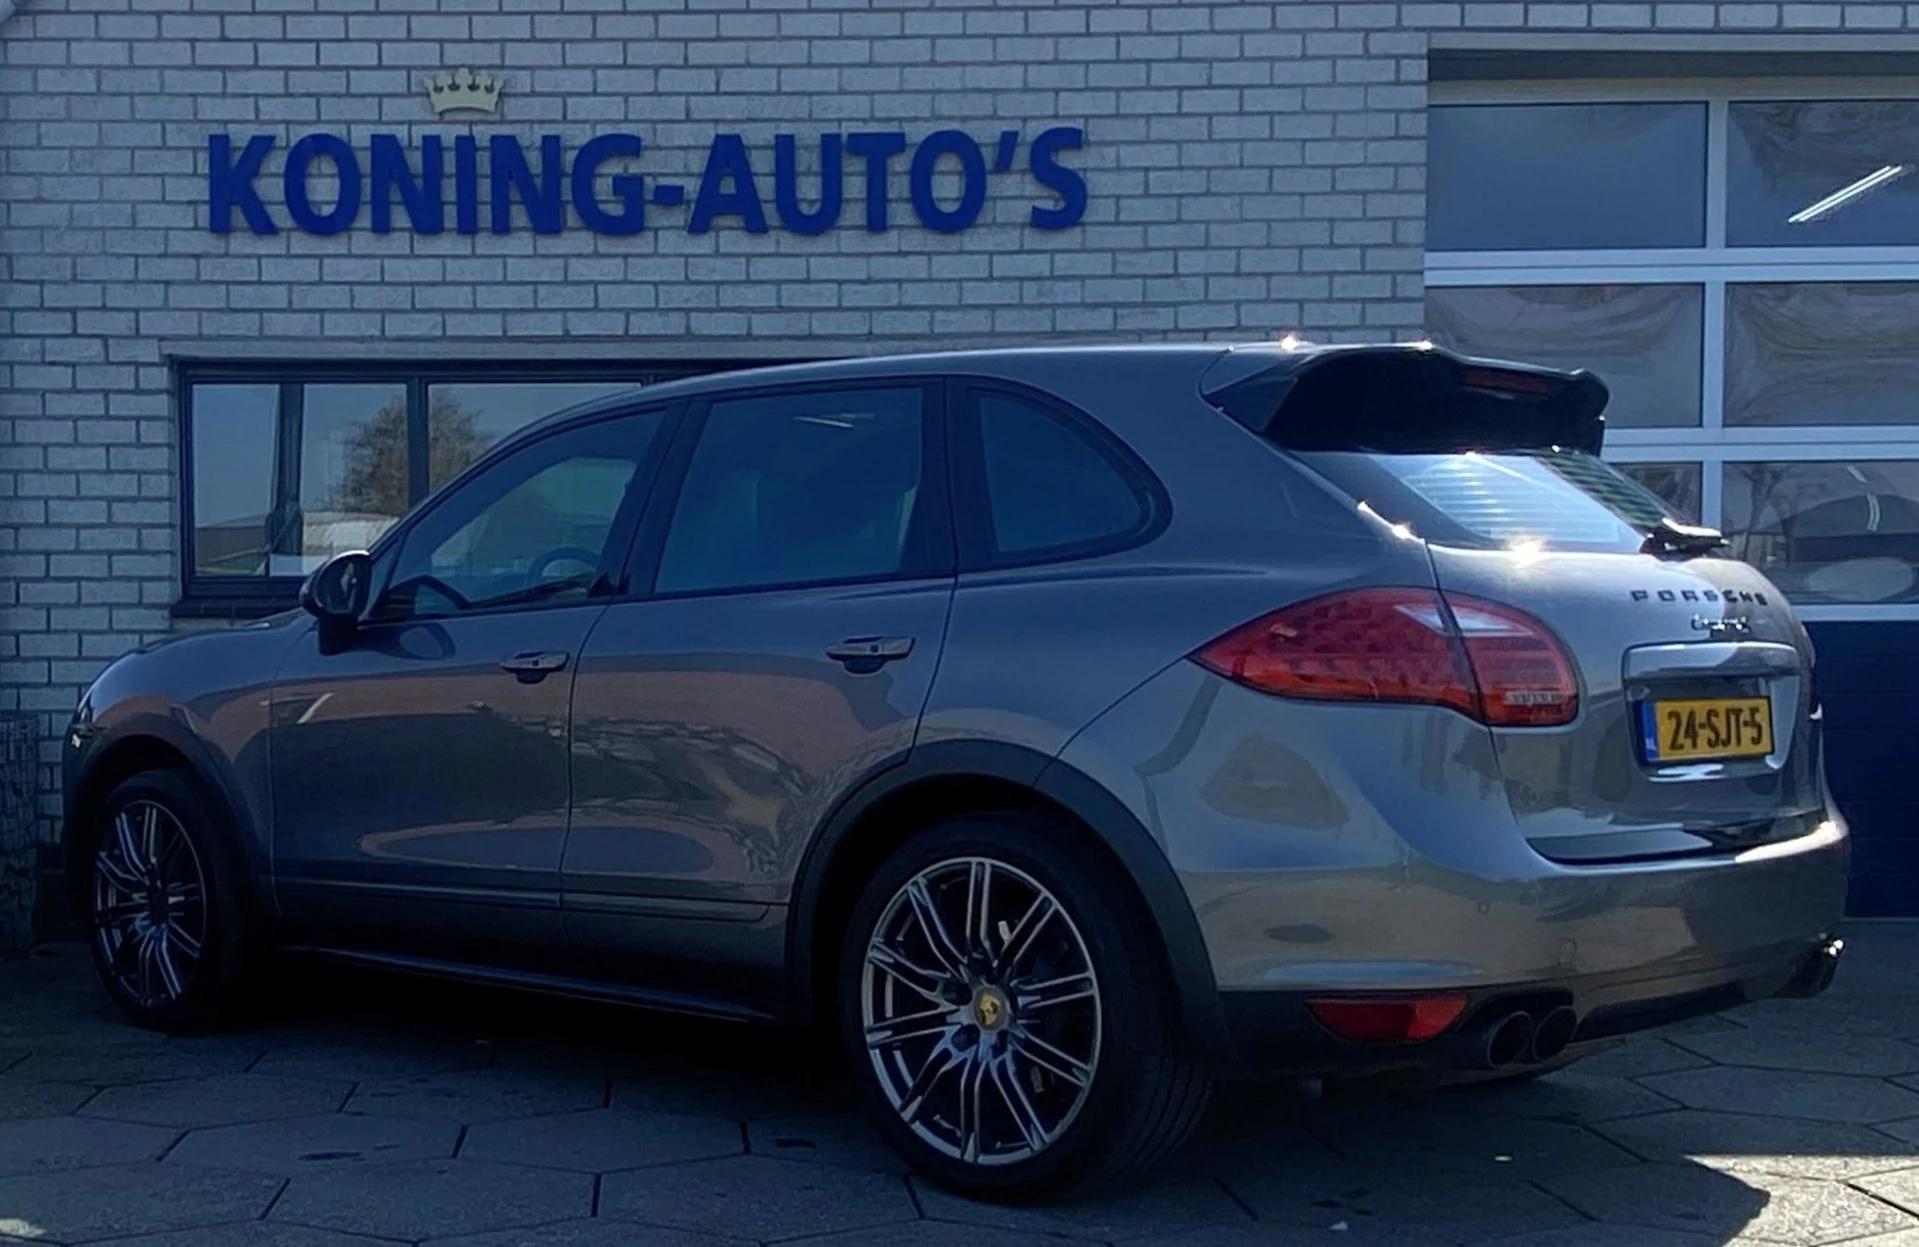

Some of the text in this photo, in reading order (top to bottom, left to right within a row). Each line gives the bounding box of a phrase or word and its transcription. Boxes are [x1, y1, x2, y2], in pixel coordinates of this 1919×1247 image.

[208, 126, 1088, 236] KONING-AUTO'S
[1630, 589, 1768, 605] PORSCHE
[1667, 707, 1763, 751] 24-SJT-5
